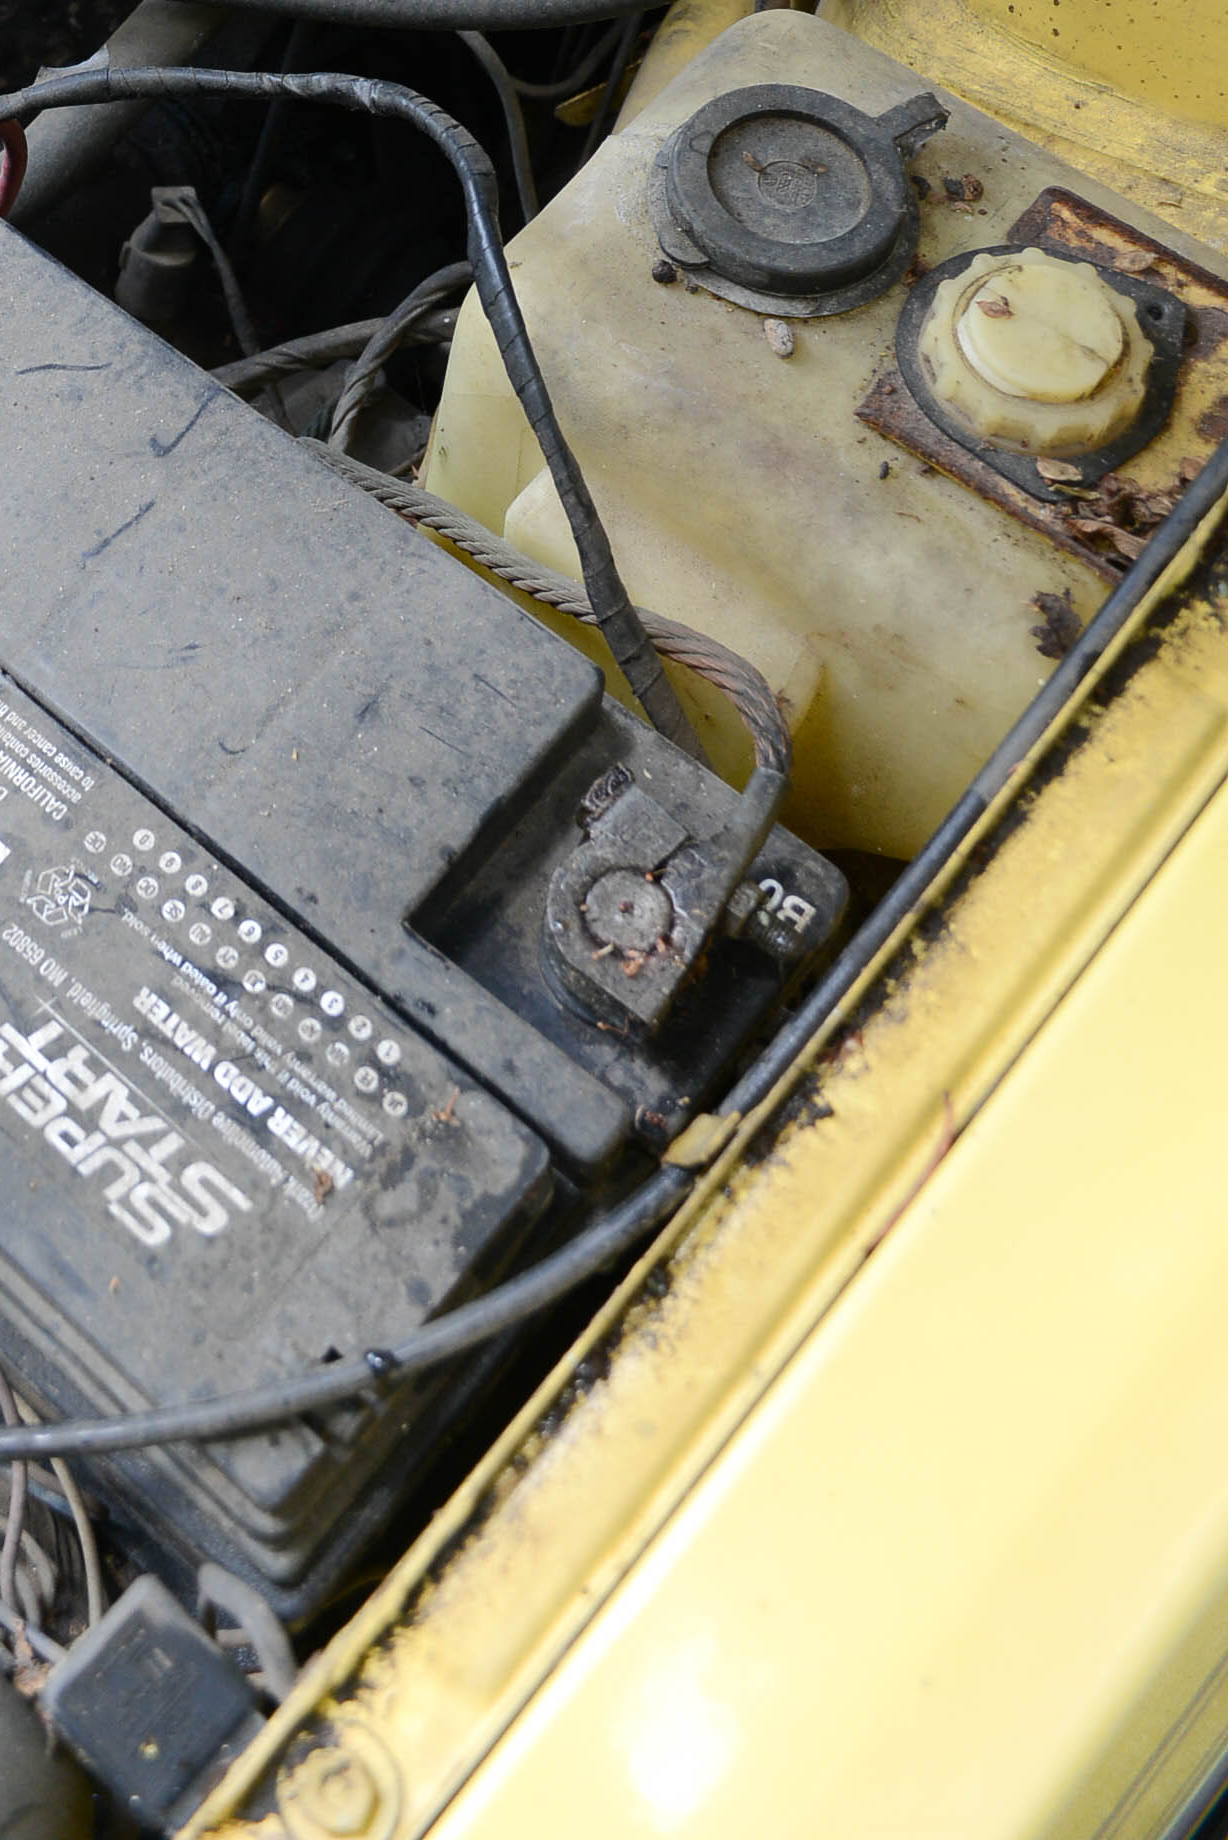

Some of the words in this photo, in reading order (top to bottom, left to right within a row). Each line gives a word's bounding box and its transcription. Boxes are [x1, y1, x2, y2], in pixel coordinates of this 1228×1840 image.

[3, 709, 27, 732] and
[24, 725, 58, 758] cancer
[23, 751, 83, 807] accessories
[52, 750, 85, 782] cause
[78, 774, 95, 792] to
[117, 905, 152, 938] sold.
[0, 921, 46, 966] 65802
[145, 932, 183, 968] when
[37, 955, 69, 987] MO
[177, 958, 219, 998] dated
[212, 990, 229, 1007] if
[222, 997, 257, 1032] only
[128, 983, 221, 1072] WATER
[219, 1018, 257, 1054] label
[249, 1024, 285, 1058] valid
[250, 1045, 280, 1075] this
[275, 1068, 292, 1085] if
[278, 1047, 339, 1105] warranty
[208, 1055, 275, 1120] ADD
[284, 1076, 319, 1109] void
[206, 1109, 289, 1188] Automotive
[262, 1104, 356, 1193] NEVER
